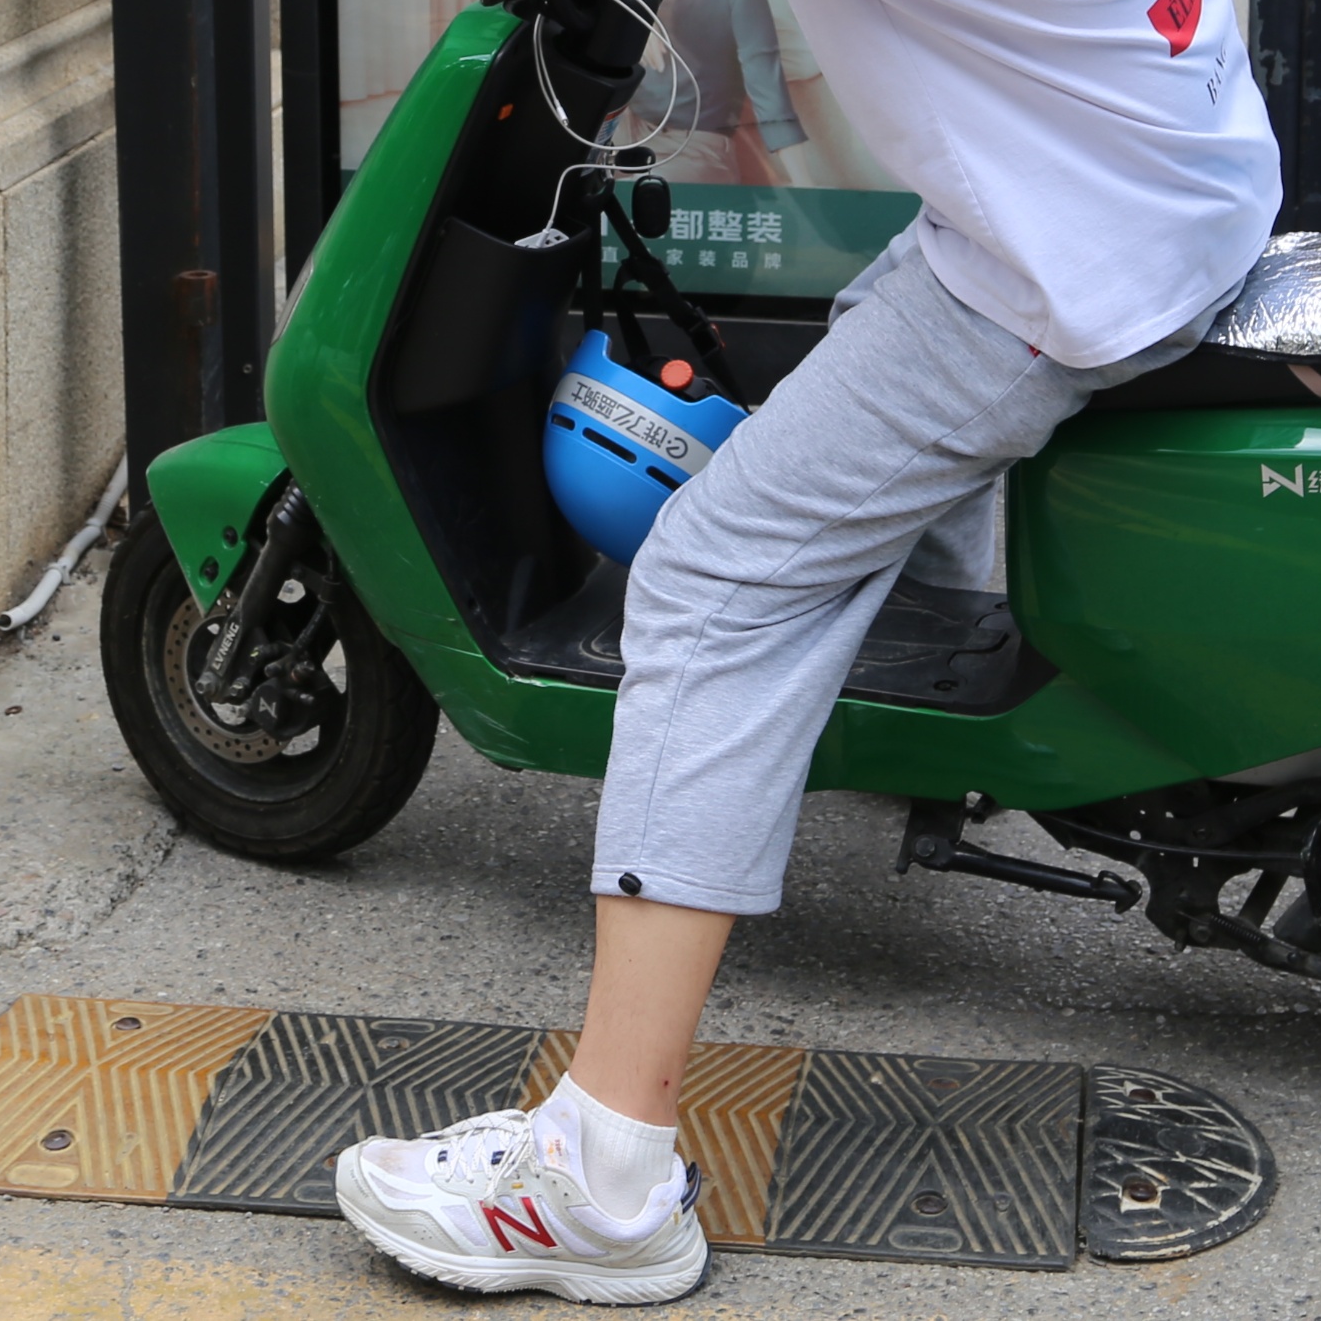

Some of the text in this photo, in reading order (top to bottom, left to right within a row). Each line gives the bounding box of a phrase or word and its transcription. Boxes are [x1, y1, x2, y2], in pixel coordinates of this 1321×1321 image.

[601, 246, 782, 270] 直家装品牌
